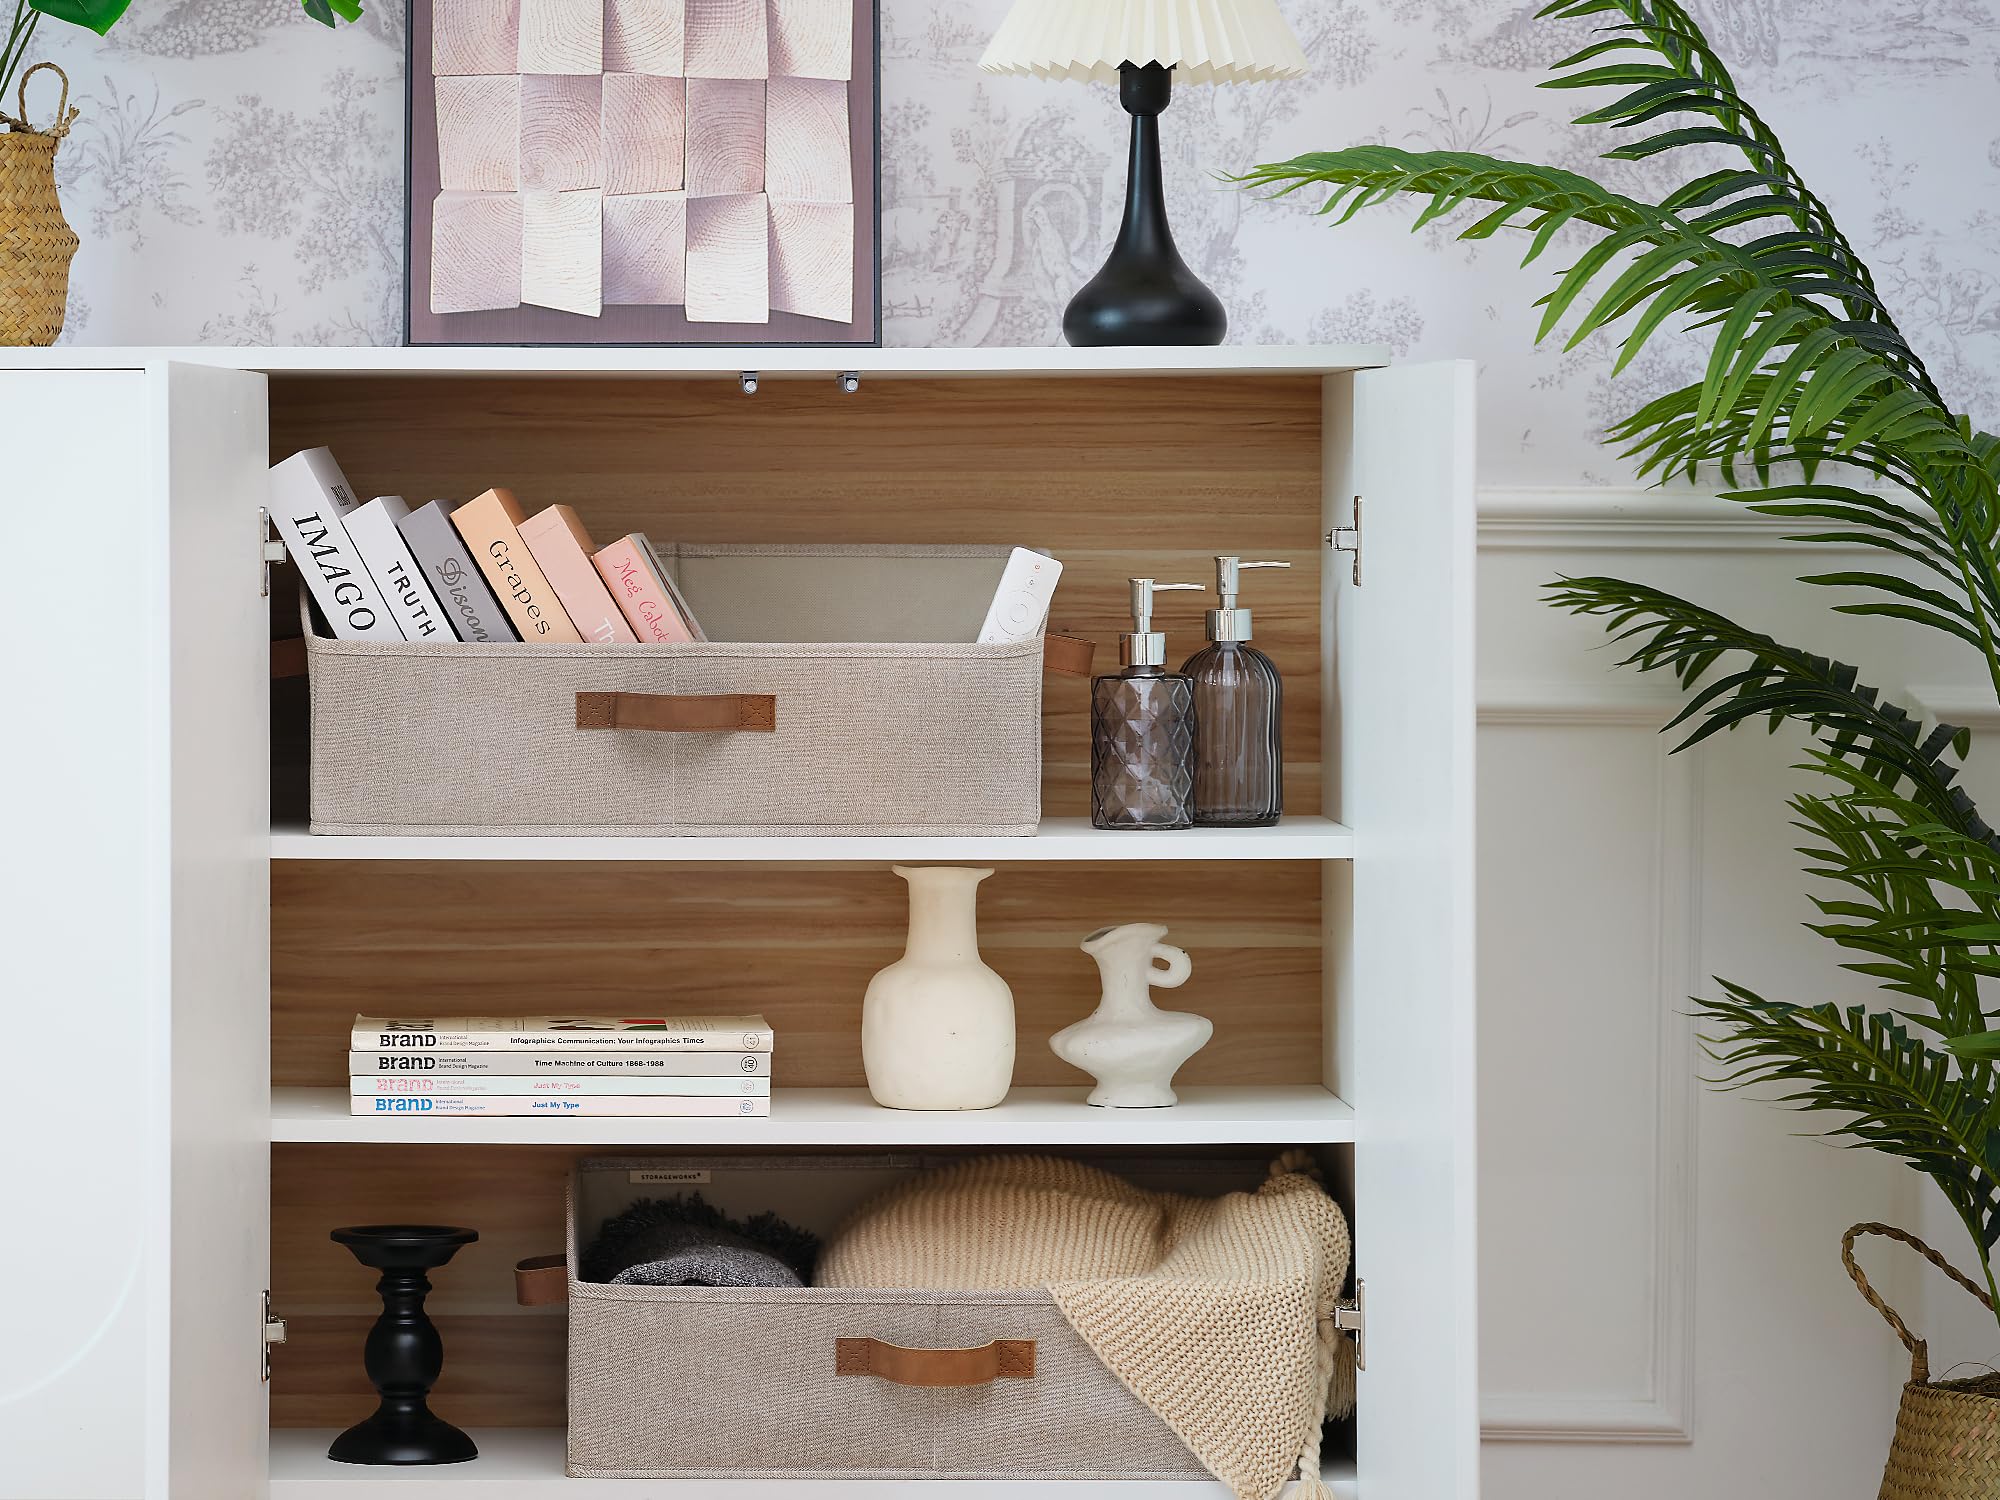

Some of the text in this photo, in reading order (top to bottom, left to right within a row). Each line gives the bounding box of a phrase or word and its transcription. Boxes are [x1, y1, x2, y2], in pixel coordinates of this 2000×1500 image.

[291, 511, 376, 631] IMAGO
[387, 560, 437, 637] TRUTH
[435, 557, 497, 642] Discon
[489, 540, 551, 635] Grapes
[612, 557, 670, 643] Meg Cabot
[510, 1037, 556, 1045] Infographics
[635, 1037, 681, 1045] Infographics
[531, 1101, 580, 1110] Just My Type
[551, 1082, 562, 1090] My
[563, 1082, 581, 1090] Type
